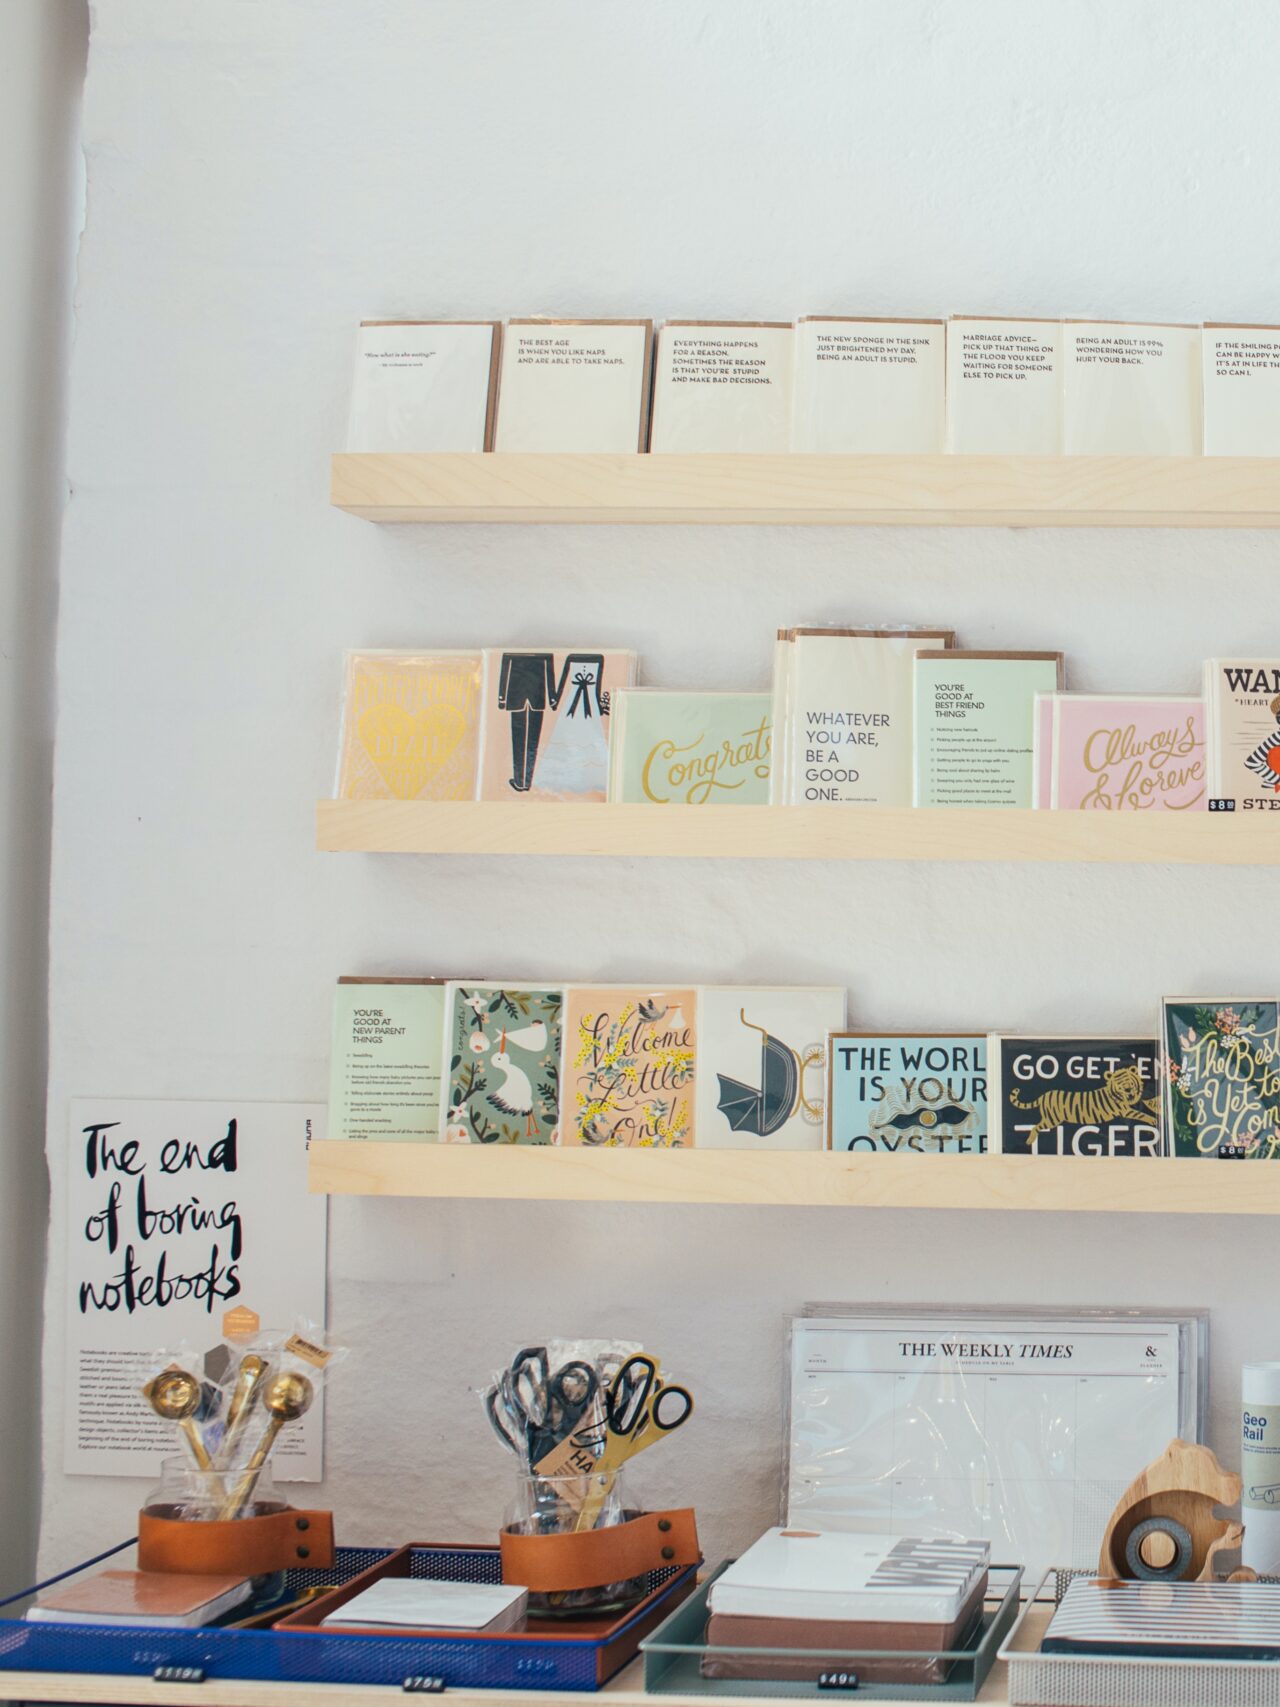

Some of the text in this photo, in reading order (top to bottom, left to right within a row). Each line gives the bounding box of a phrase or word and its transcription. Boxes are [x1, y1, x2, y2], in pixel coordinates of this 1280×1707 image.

[806, 712, 890, 727] WHATEVER
[806, 730, 878, 747] YOU ARE,
[1084, 716, 1204, 772] Always
[806, 750, 839, 763] BE A
[806, 768, 859, 782] GOOD
[805, 788, 844, 801] ONE.
[581, 1012, 695, 1068] Welcome
[838, 1047, 986, 1072] THE WORL
[1013, 1054, 1059, 1080] GO
[1066, 1056, 1120, 1079] GET
[1181, 1032, 1225, 1082] The
[859, 1076, 987, 1102] IS YOUR
[1182, 1079, 1258, 1152] Yet
[1188, 1098, 1206, 1125] is
[82, 1121, 146, 1178] The
[160, 1118, 237, 1174] end
[86, 1174, 242, 1260] of boring
[80, 1244, 240, 1314] notebooks
[899, 1343, 1073, 1358] THE WEEKLY TIMES
[1243, 1412, 1266, 1426] Geo
[1244, 1426, 1263, 1440] Rail
